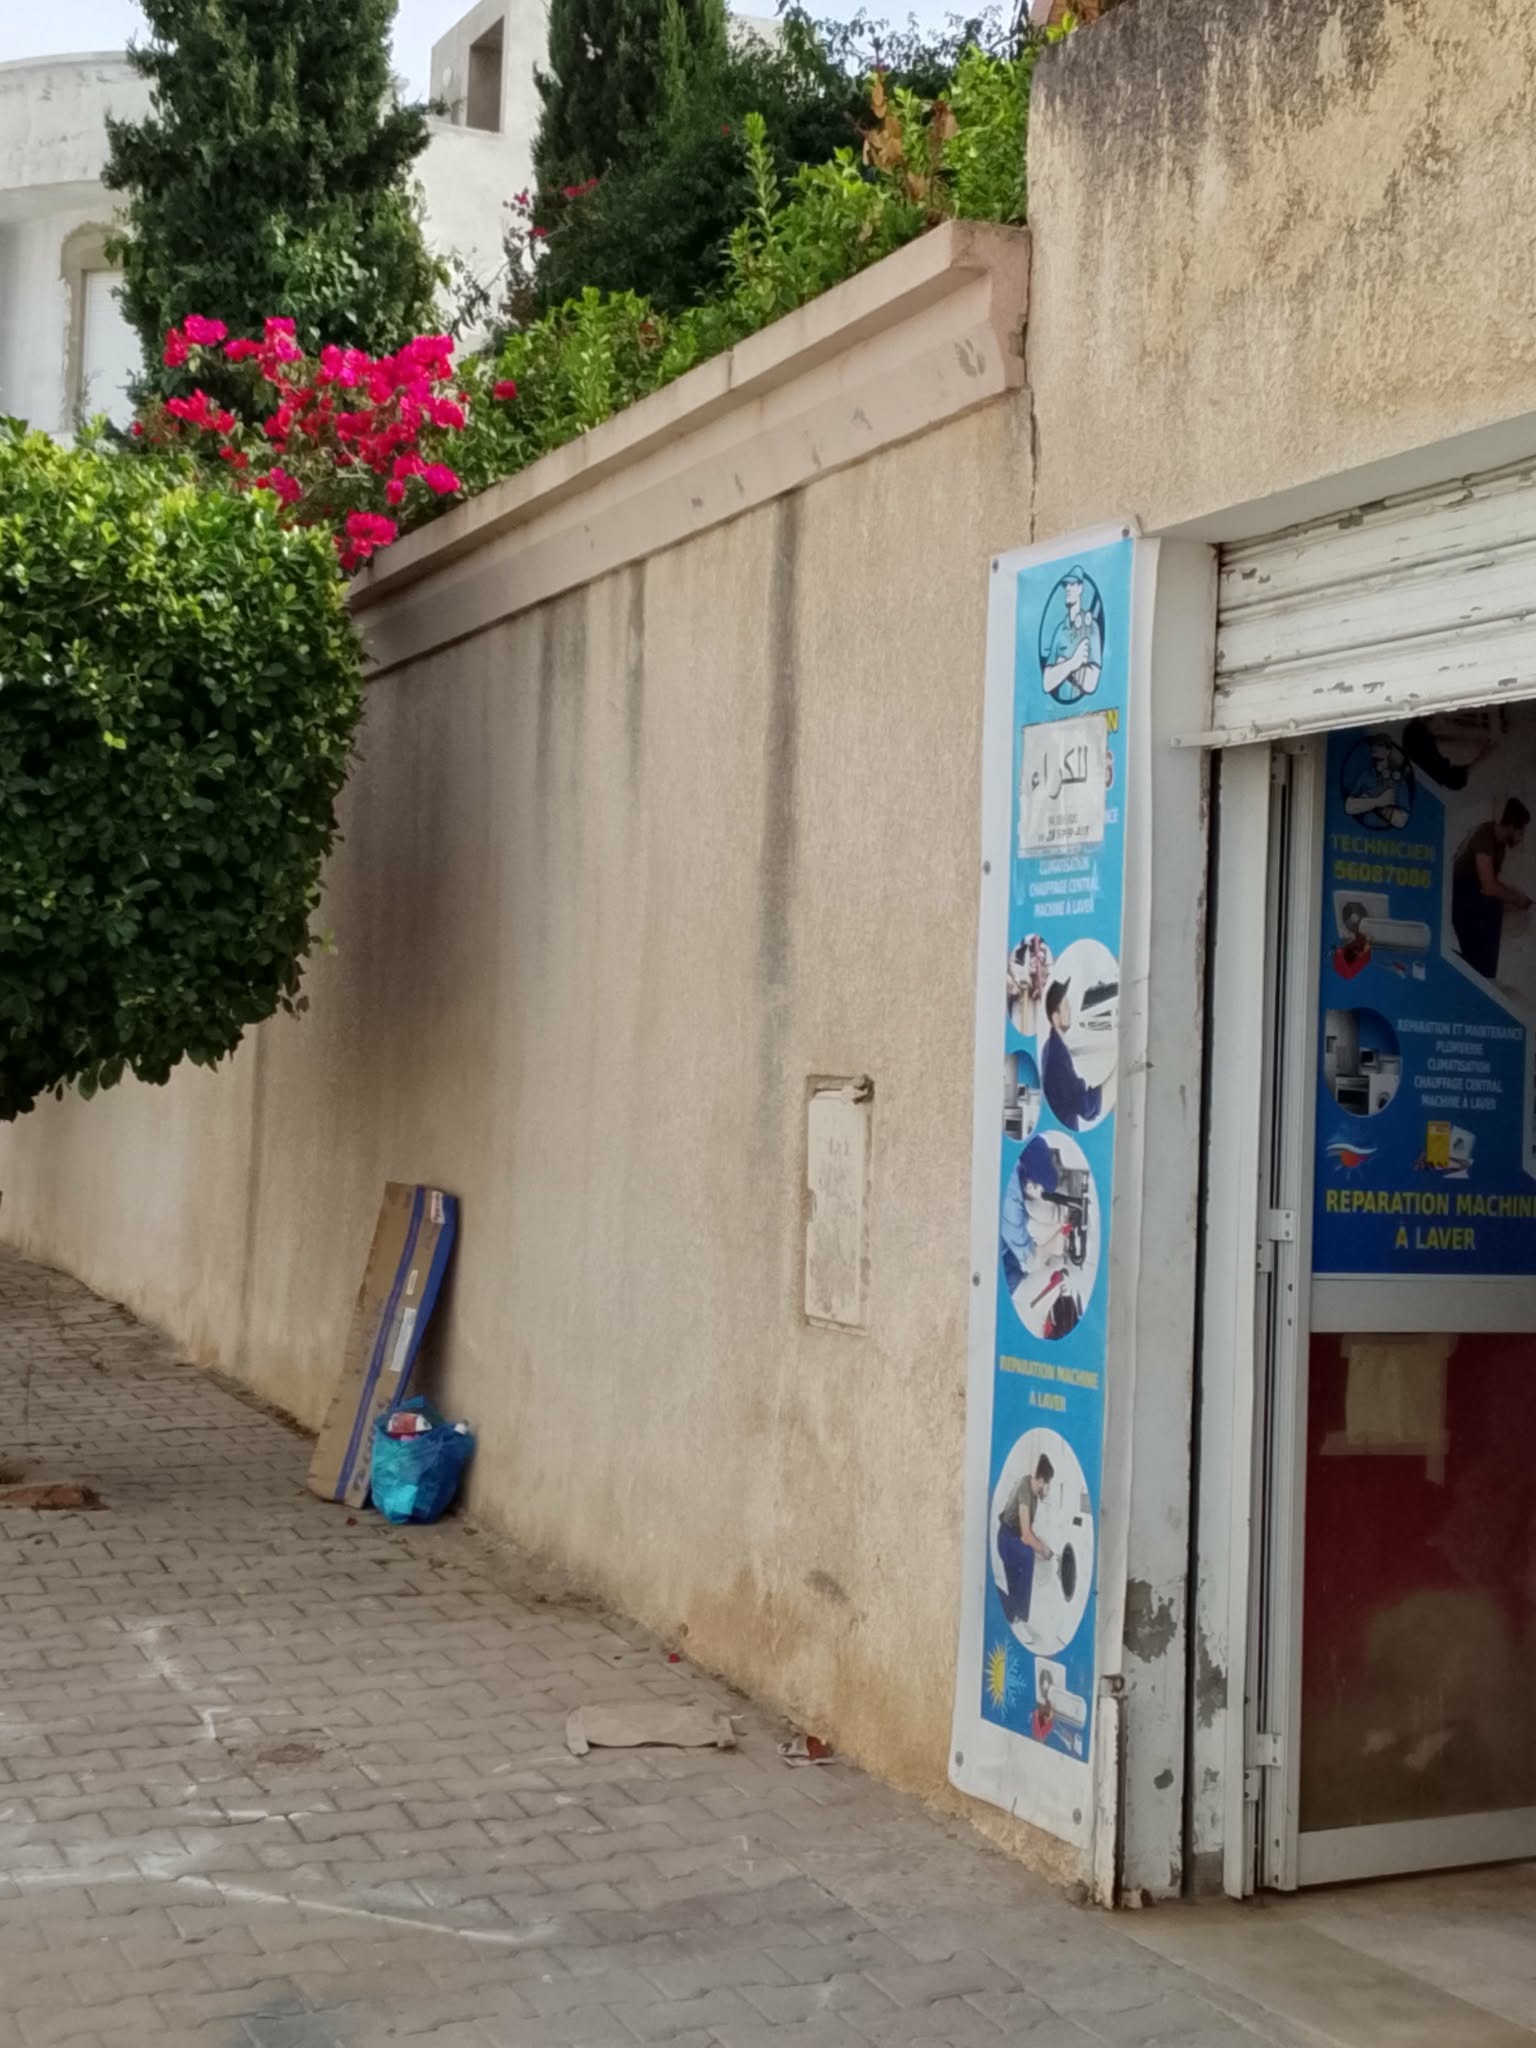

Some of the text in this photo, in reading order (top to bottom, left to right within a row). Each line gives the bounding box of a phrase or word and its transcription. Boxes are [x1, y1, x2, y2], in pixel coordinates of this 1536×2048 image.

[1030, 745, 1088, 801] للكراء
[1414, 1075, 1503, 1094] CHAUFFAGE CENTRAL
[1421, 1094, 1460, 1109] MACHINE
[1470, 1095, 1497, 1111] LAVER
[1326, 1189, 1449, 1216] REPARATION
[1416, 1227, 1477, 1251] LAVER
